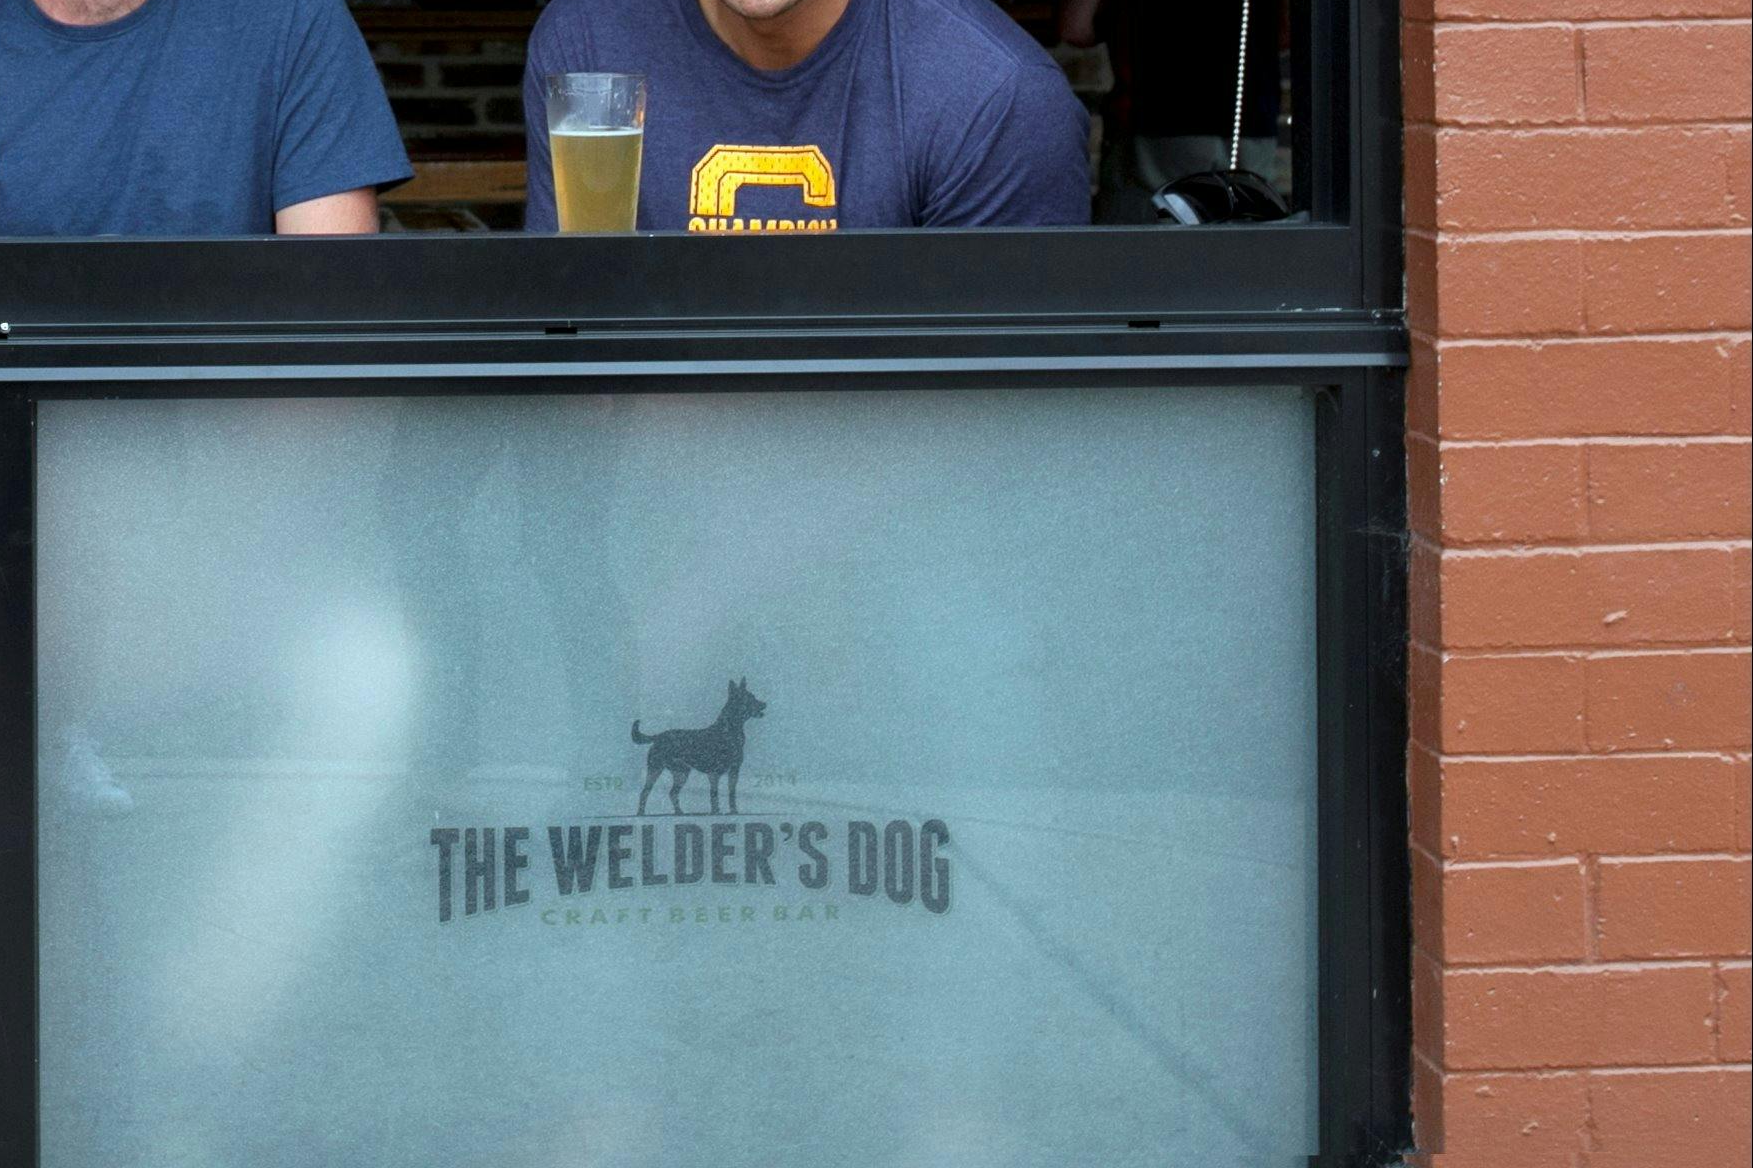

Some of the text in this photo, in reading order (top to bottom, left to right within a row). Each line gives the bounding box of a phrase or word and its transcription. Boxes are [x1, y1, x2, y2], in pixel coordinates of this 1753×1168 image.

[430, 818, 951, 923] THE WELDER'S DOG
[540, 903, 840, 926] CRAFT BEER BAR
